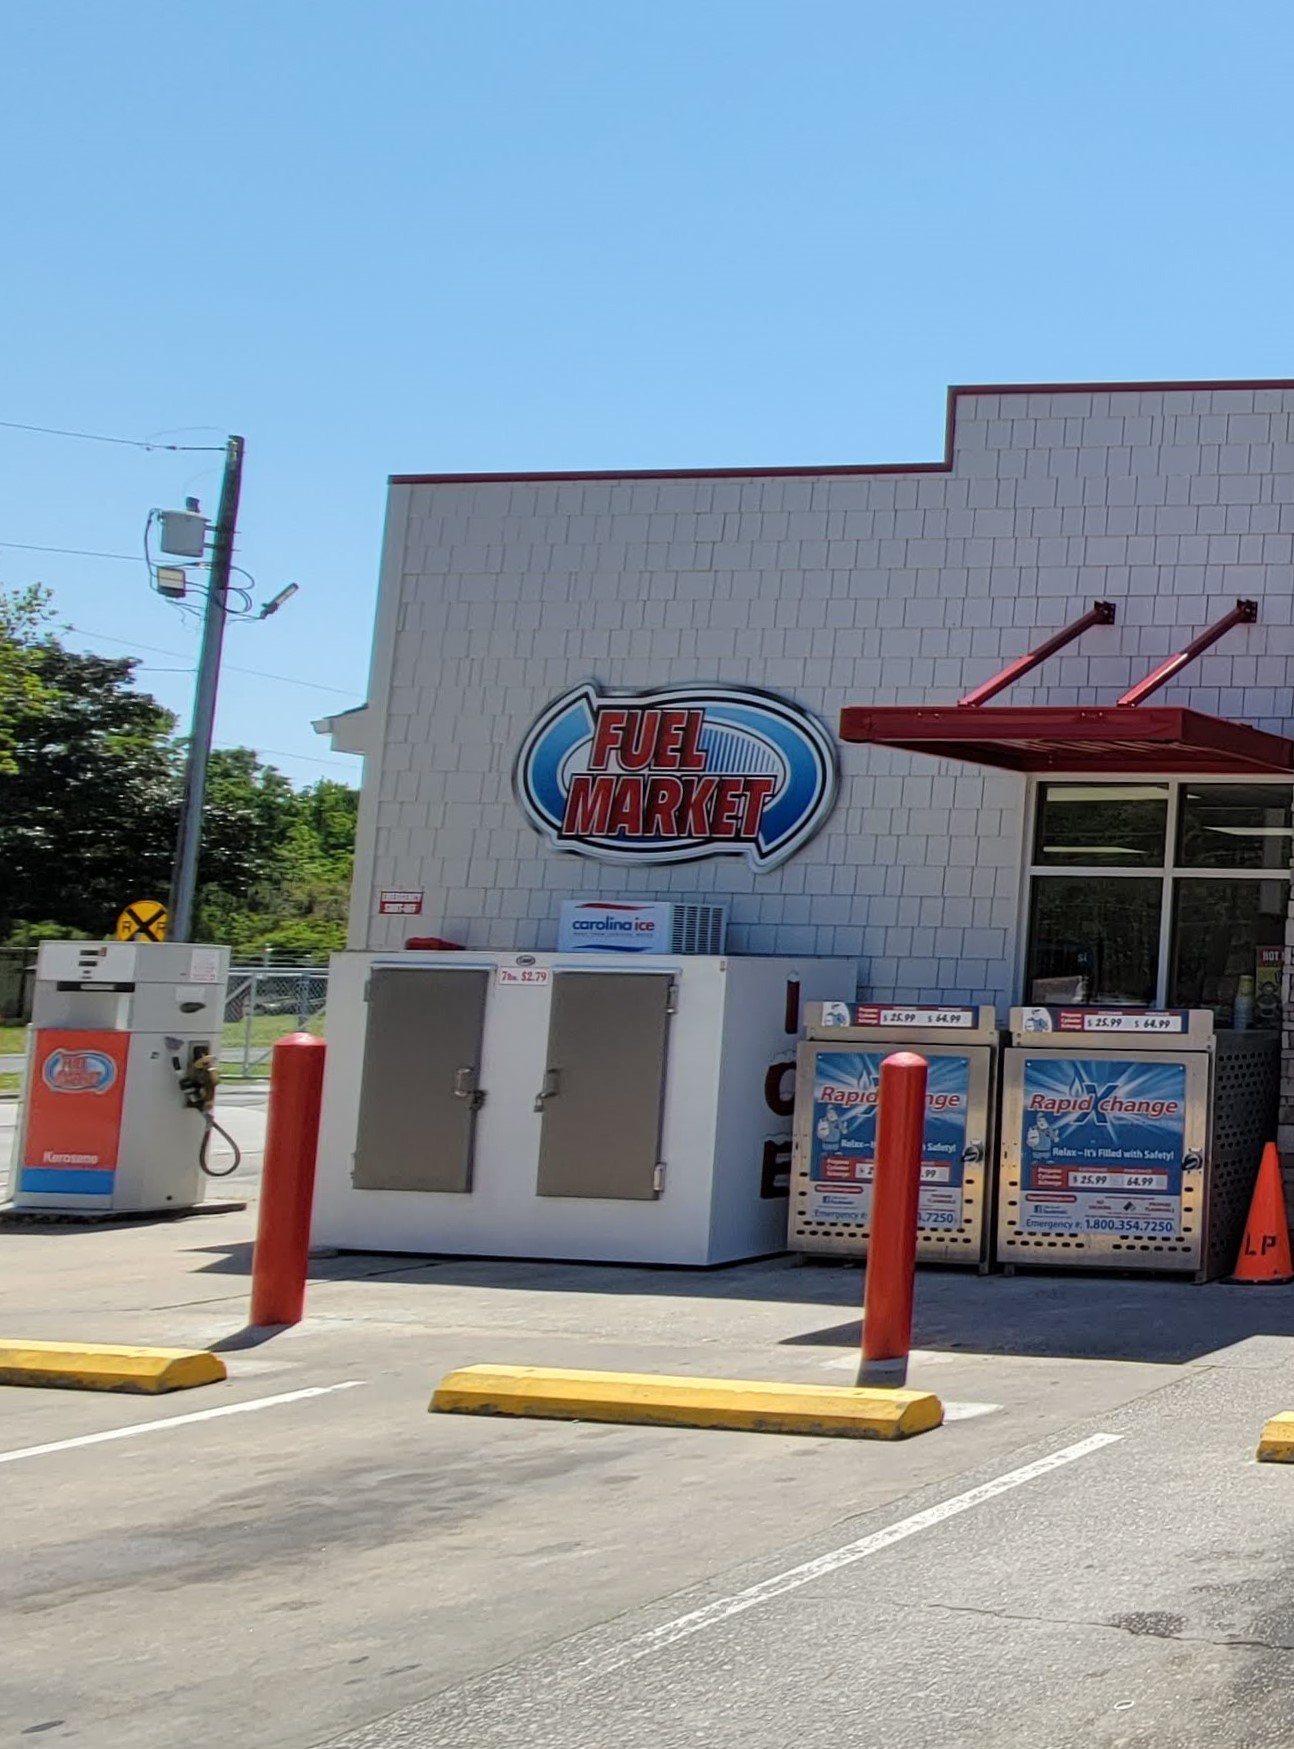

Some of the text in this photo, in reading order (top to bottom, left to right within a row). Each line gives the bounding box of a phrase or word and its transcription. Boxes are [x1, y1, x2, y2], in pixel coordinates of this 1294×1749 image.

[590, 709, 705, 770] FUEL
[561, 775, 775, 837] MARKET
[122, 920, 131, 932] R
[572, 915, 655, 931] carolina ice
[521, 970, 547, 981] $2.79
[890, 1013, 916, 1022] 25.99
[935, 1014, 961, 1023] 64.99
[1095, 1018, 1122, 1027] 25.99
[1143, 1019, 1171, 1028] 64.99
[841, 1139, 863, 1148] Relax
[43, 1150, 99, 1165] Kerosene
[1052, 1147, 1076, 1157] Relax
[1099, 1149, 1121, 1158] Filled
[1124, 1149, 1143, 1159] with
[1145, 1150, 1174, 1161] Safety!
[1080, 1175, 1107, 1185] 25.99
[1126, 1177, 1154, 1187] 64.99
[814, 1209, 859, 1221] Emergency
[1025, 1218, 1074, 1230] Emergency
[1085, 1218, 1173, 1232] 1.800.354.7250
